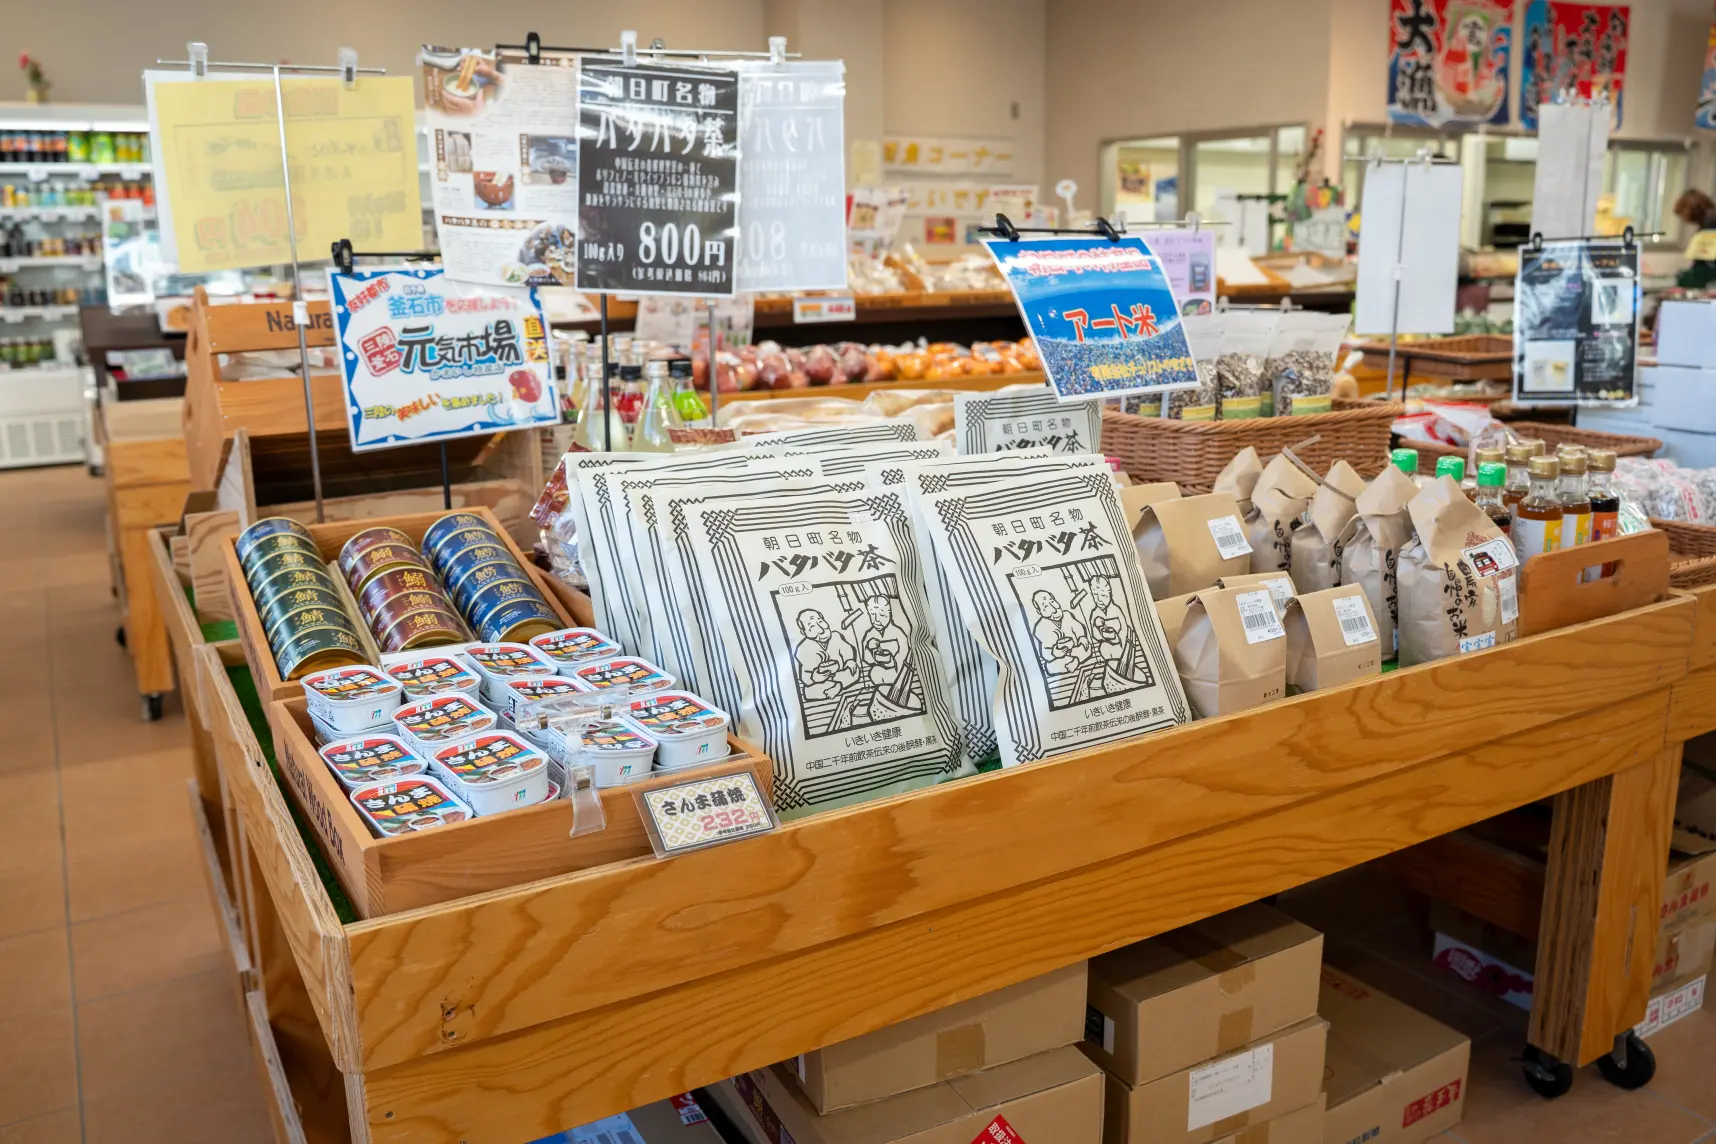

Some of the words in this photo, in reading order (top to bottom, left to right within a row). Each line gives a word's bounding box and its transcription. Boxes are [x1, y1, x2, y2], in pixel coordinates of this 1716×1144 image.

[638, 221, 726, 267] 800円
[1063, 303, 1160, 344] アート米
[398, 319, 523, 371] 元気市場
[523, 315, 548, 363] 直送
[1002, 417, 1072, 435] 朝日町名物
[991, 507, 1084, 537] 朝日町名物
[762, 530, 863, 551] 朝日町名物
[993, 521, 1113, 566] バタバタ茶
[758, 543, 896, 581] バタバタ茶
[1444, 562, 1468, 638] 自慢のお米
[404, 701, 464, 723] さんま
[1084, 698, 1133, 719] いきいき健康
[845, 726, 902, 748] いきいき健康
[332, 743, 395, 763] さんま
[446, 739, 511, 766] さんま
[363, 785, 432, 809] さんま
[661, 786, 747, 816] さんま蒲焼
[700, 808, 761, 832] 232円
